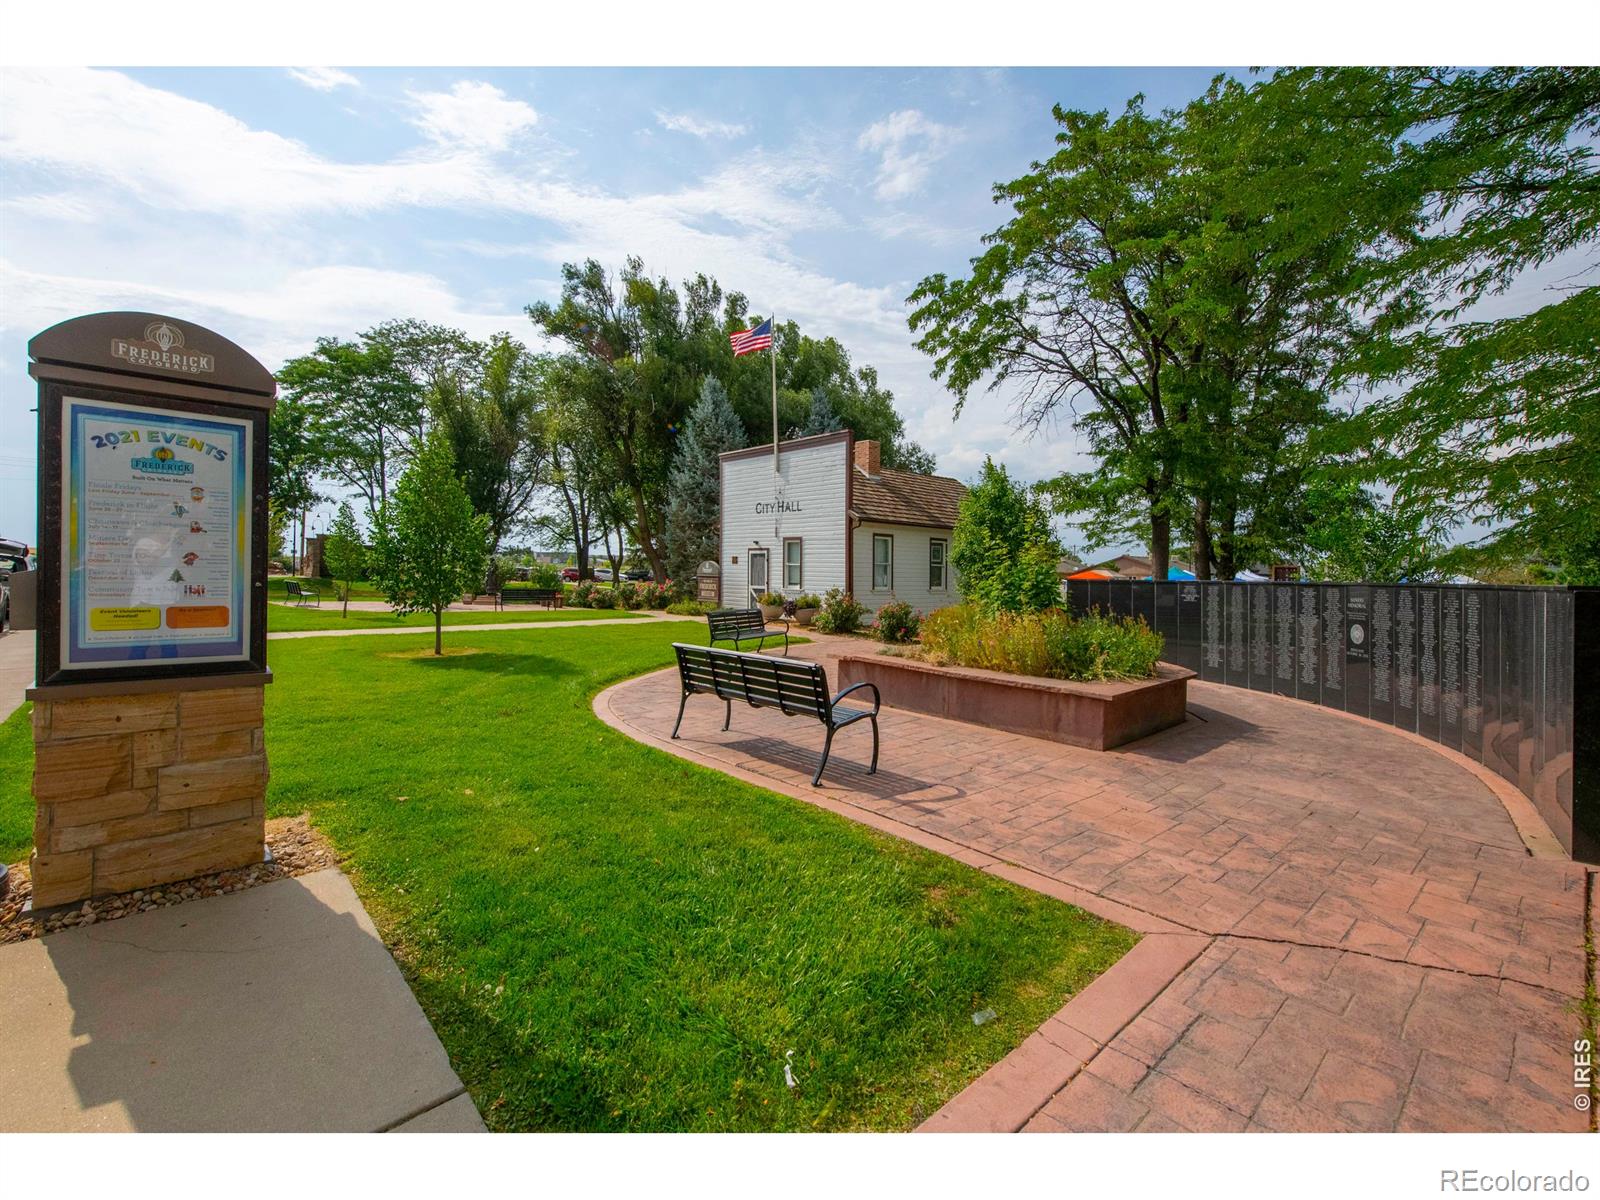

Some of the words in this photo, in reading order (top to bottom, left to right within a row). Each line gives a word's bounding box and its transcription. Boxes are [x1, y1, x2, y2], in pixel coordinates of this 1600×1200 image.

[118, 342, 209, 369] FREDERICK
[130, 357, 198, 373] COLORADO
[90, 430, 141, 449] 2021
[146, 430, 228, 462] EVENTS
[135, 460, 192, 473] FREDERICK
[755, 502, 776, 514] CITY
[777, 500, 802, 513] HALL
